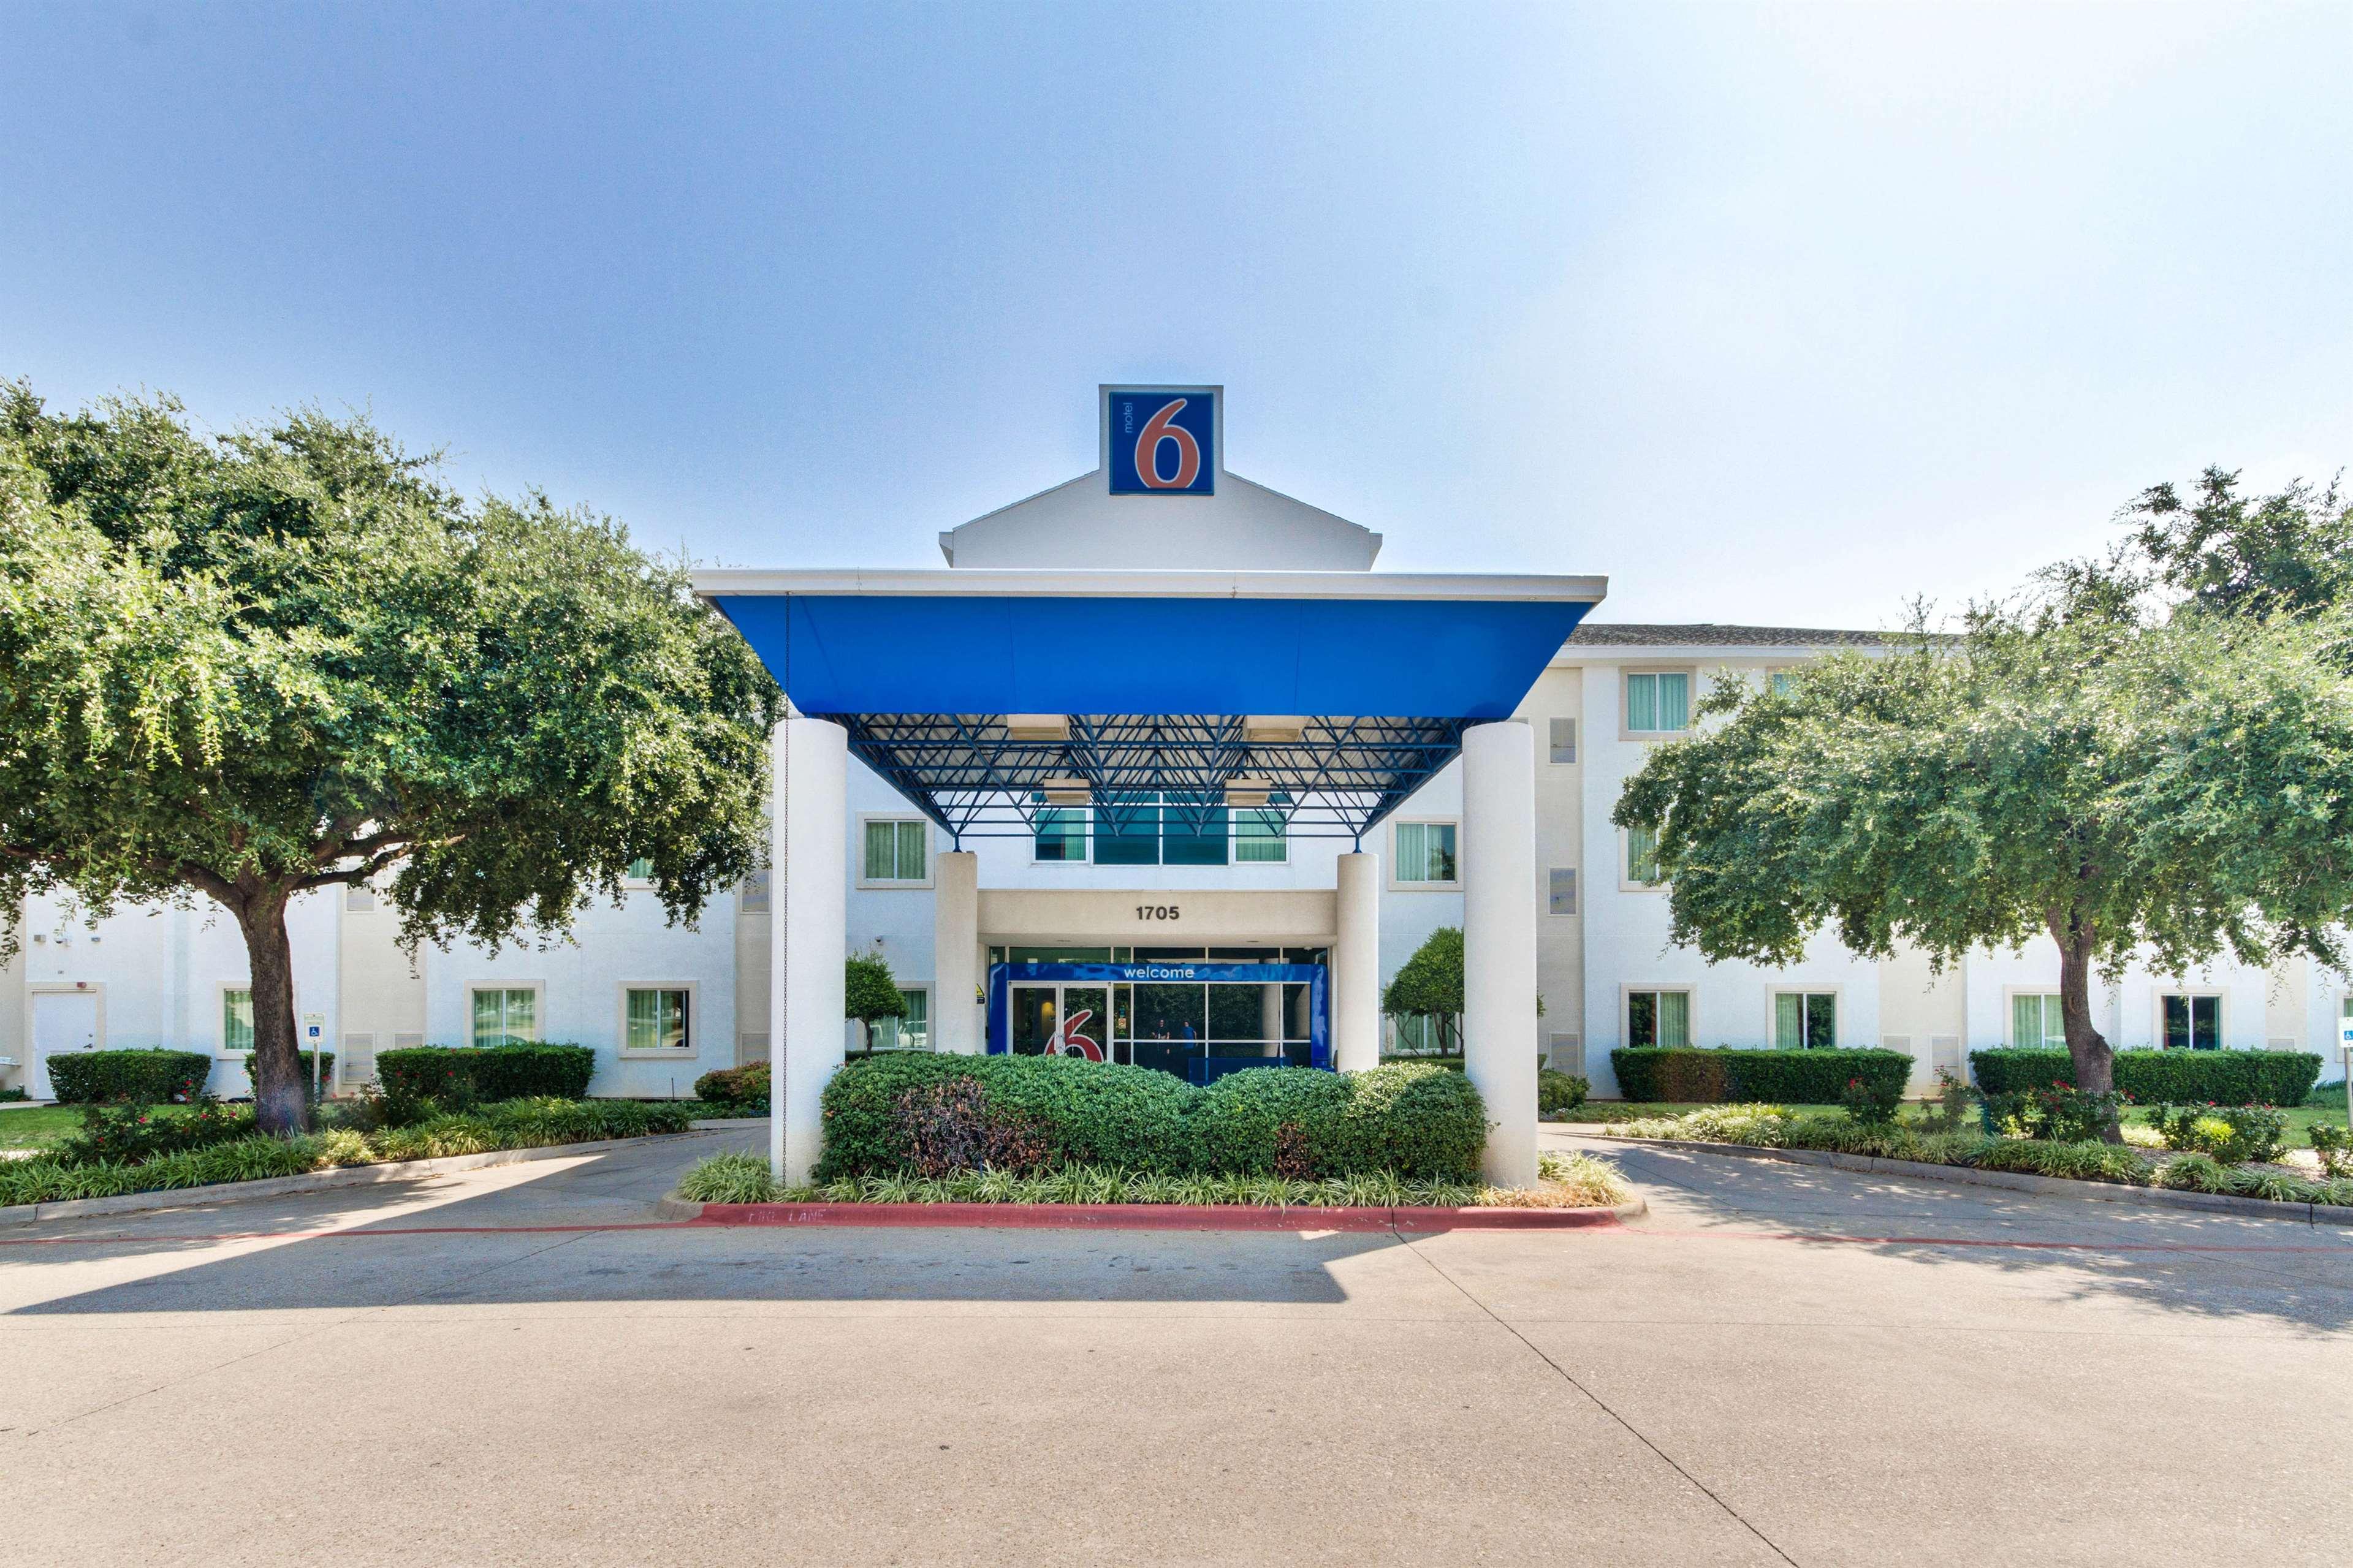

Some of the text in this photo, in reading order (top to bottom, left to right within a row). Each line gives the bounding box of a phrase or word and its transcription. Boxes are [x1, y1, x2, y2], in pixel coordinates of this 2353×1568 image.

[1123, 398, 1201, 488] motel 6
[1136, 906, 1180, 920] 1705
[1123, 966, 1195, 979] welcome
